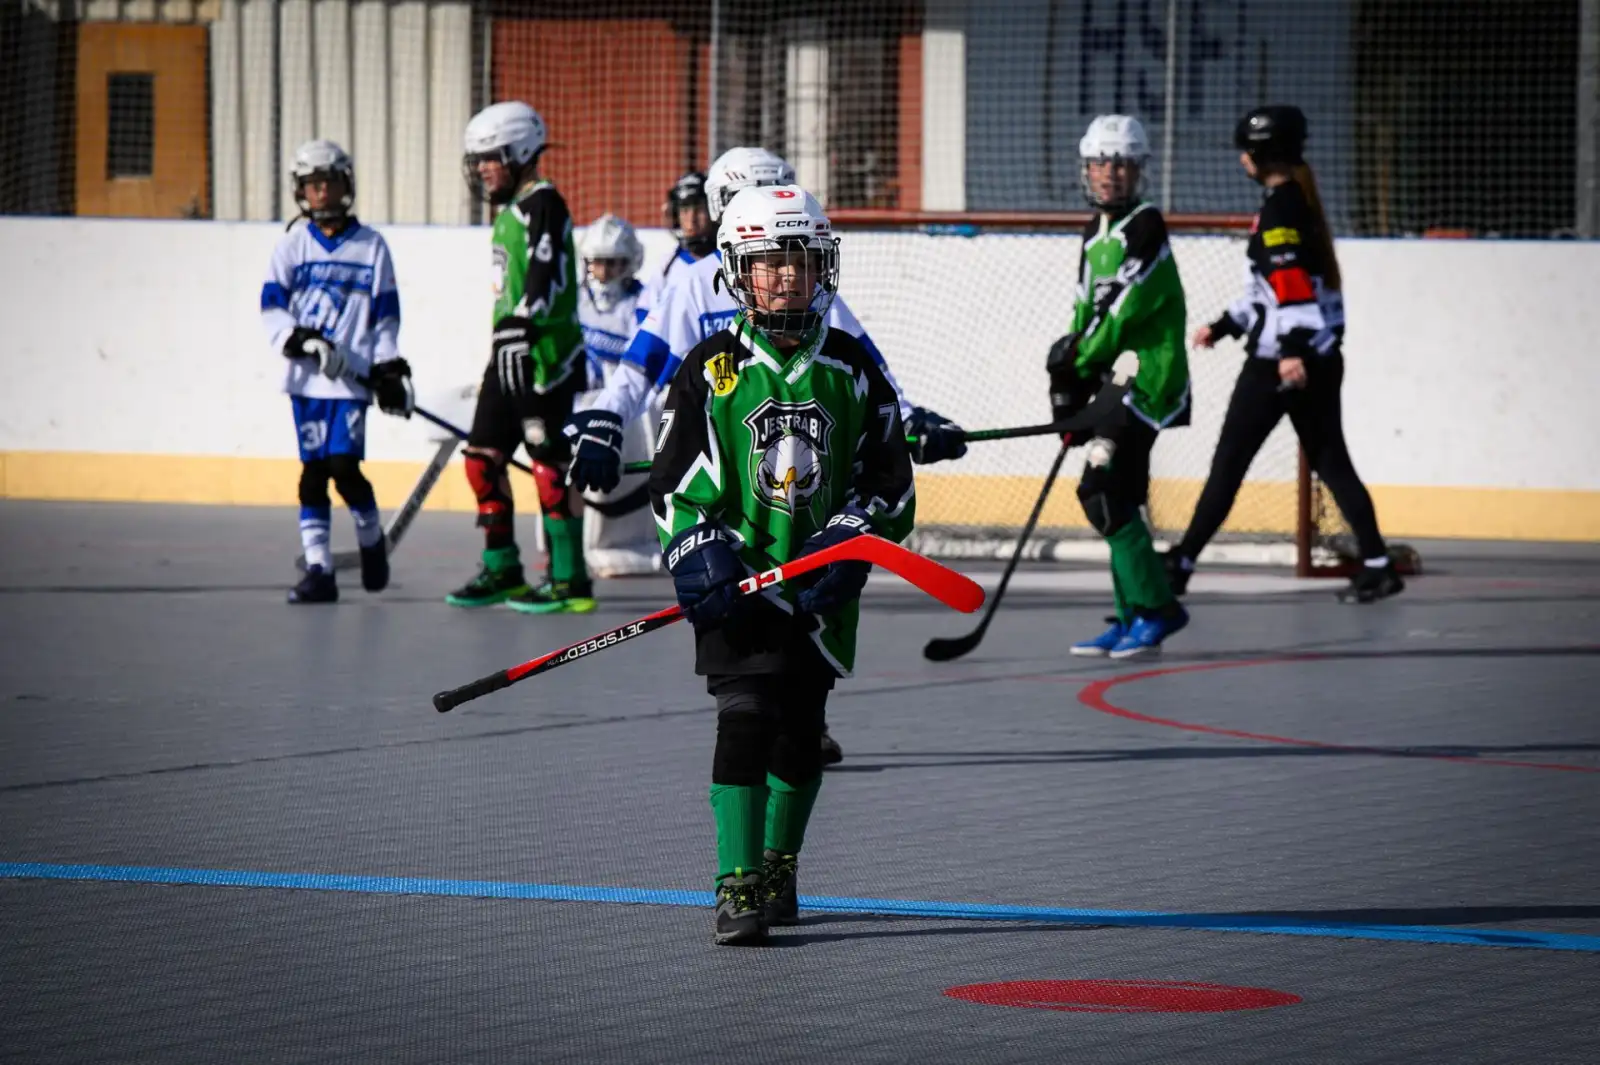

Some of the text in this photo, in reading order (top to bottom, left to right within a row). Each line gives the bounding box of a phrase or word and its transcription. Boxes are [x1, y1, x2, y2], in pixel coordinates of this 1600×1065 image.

[775, 219, 810, 229] CCM
[655, 409, 676, 453] 7
[878, 402, 899, 443] 7
[826, 513, 872, 535] BAU
[668, 528, 728, 571] BAUE
[738, 566, 784, 595] CC
[567, 620, 647, 661] JETSPEED
